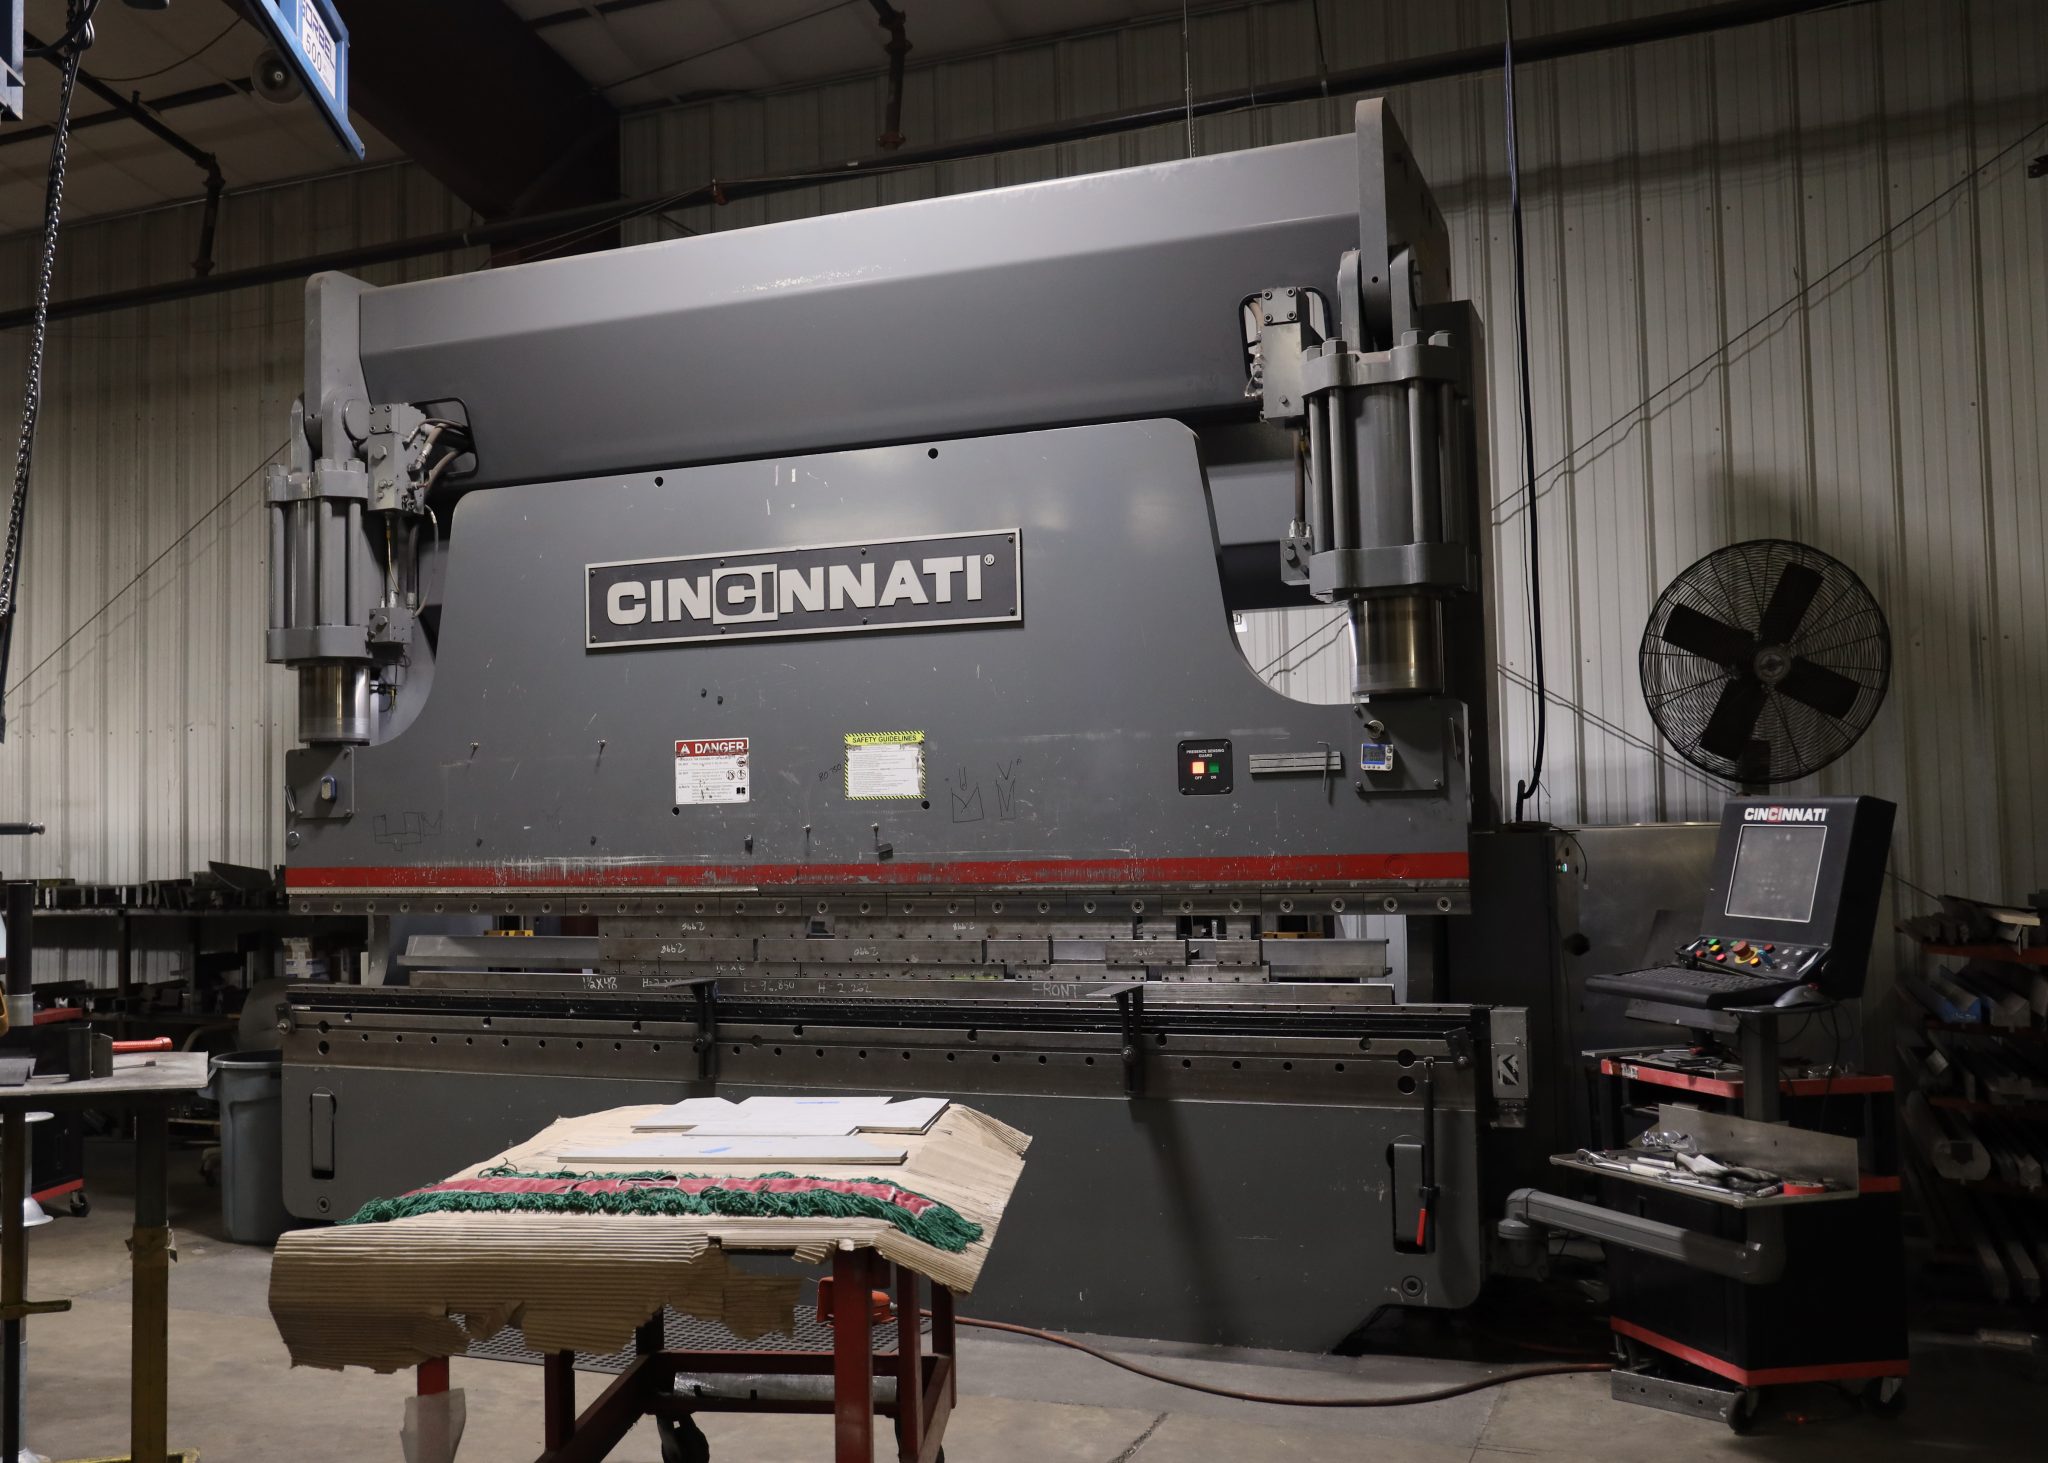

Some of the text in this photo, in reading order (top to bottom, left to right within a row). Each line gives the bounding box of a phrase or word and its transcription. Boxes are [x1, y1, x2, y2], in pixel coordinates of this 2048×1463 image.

[302, 2, 335, 69] ORBEL
[305, 33, 322, 72] 500
[606, 554, 983, 626] CINCINNATI
[852, 734, 917, 744] SAFETY GUIDELINES
[695, 741, 744, 754] DANGER
[1744, 806, 1827, 822] CINCINNATI
[1032, 983, 1082, 999] FRONT
